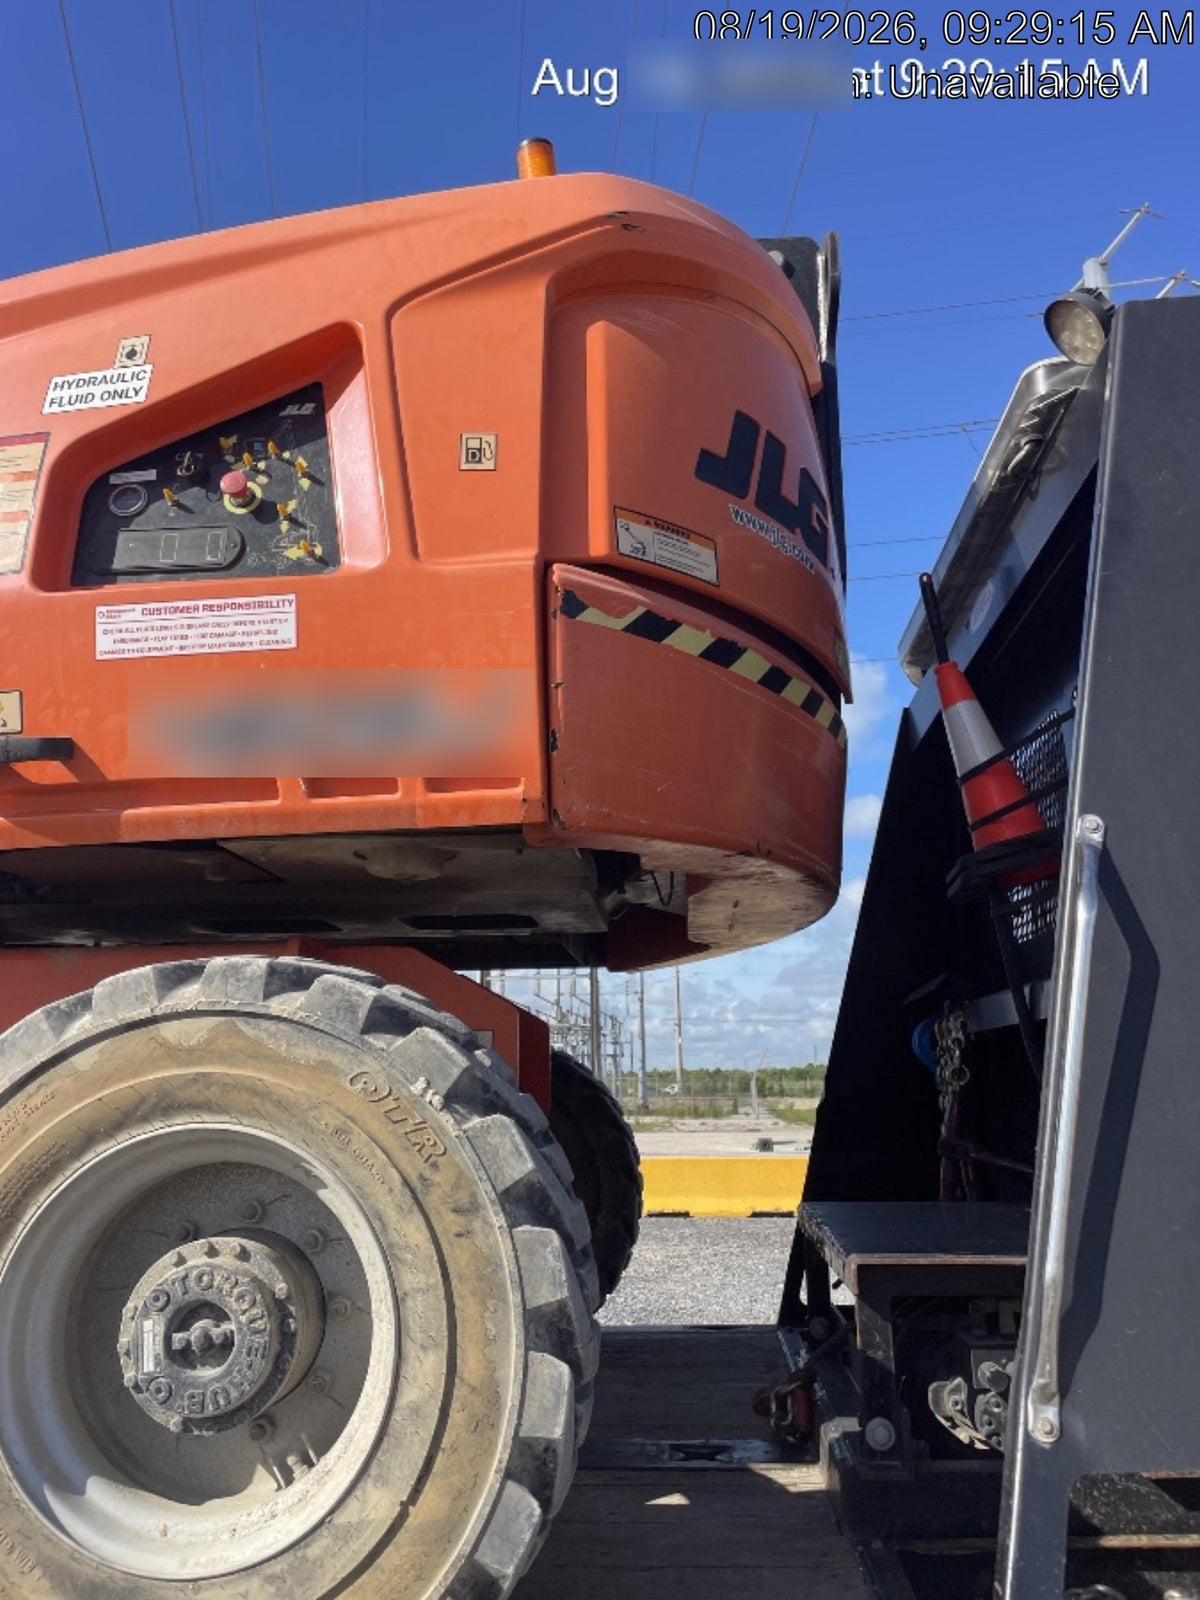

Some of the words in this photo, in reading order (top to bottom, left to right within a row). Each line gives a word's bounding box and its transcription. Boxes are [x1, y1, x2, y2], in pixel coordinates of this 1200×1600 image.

[52, 369, 147, 392] HYDRAULIC
[49, 392, 95, 409] FLUID
[100, 385, 144, 402] ONLY
[695, 409, 829, 571] JLG
[141, 602, 200, 616] CUSTOMER
[201, 598, 294, 613] RESPONSIBILITY
